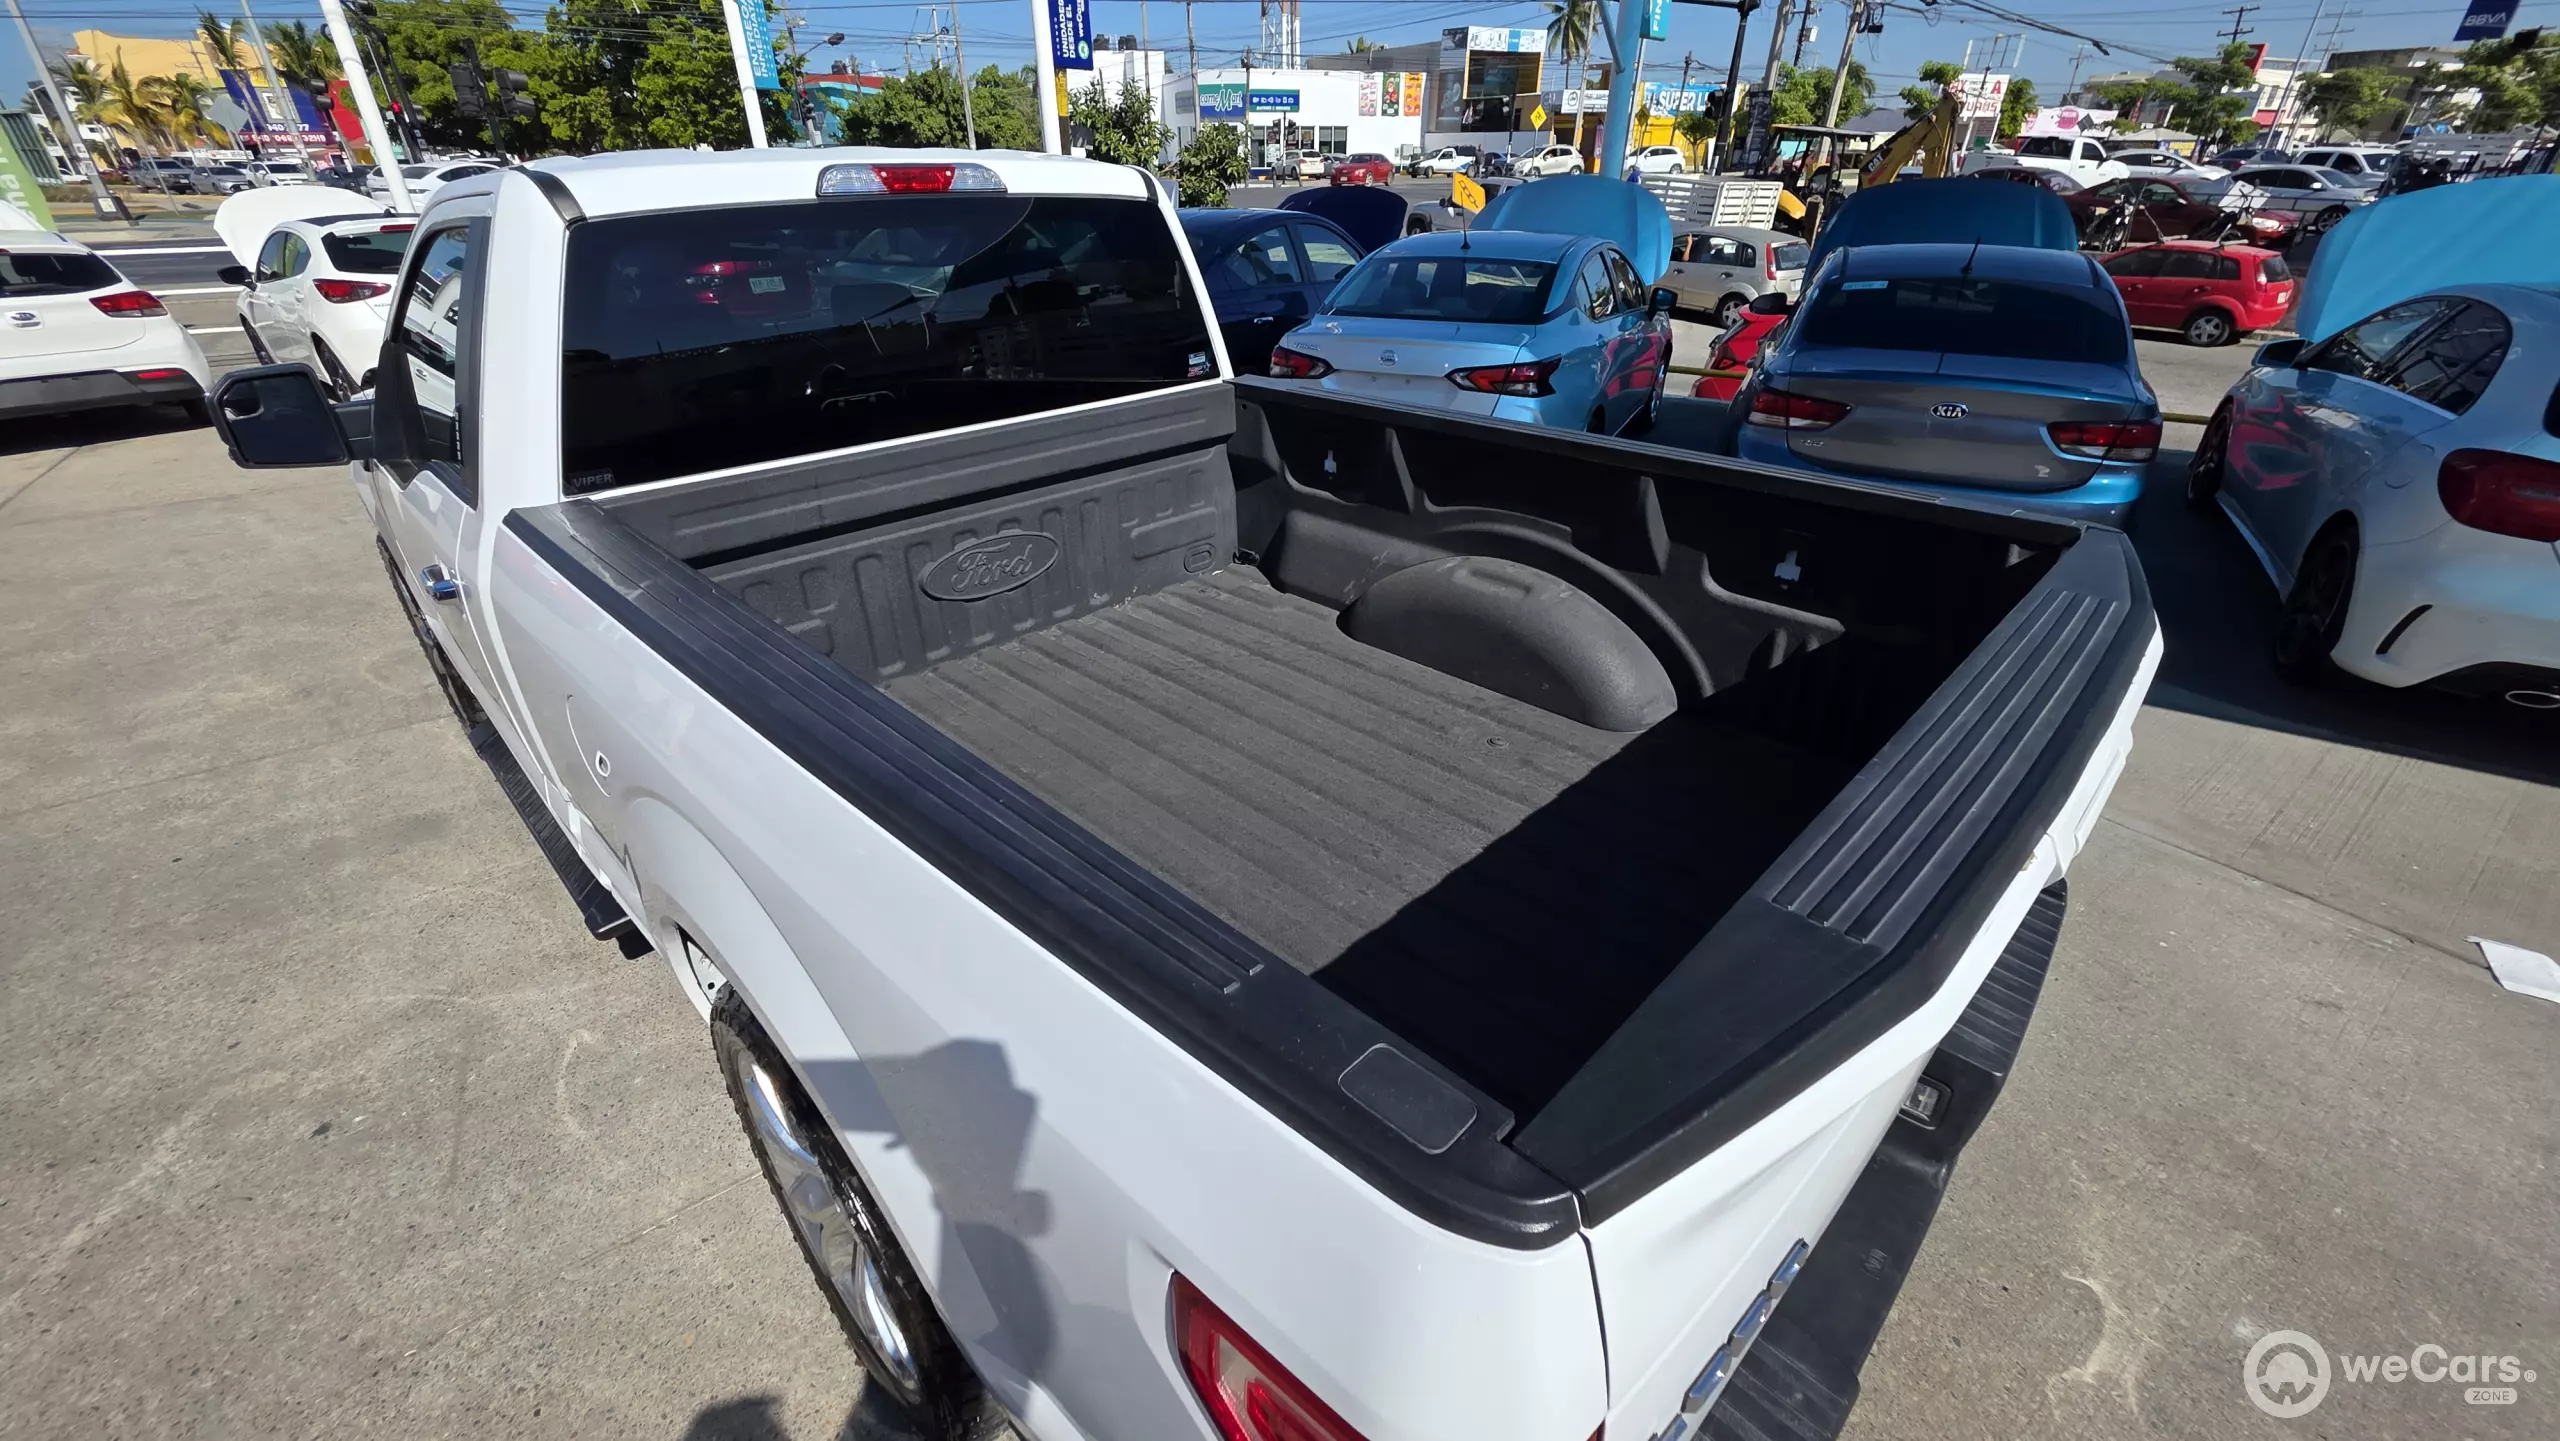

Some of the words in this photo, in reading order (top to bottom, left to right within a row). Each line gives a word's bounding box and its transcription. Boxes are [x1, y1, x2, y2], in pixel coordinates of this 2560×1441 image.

[1065, 3, 1072, 18] EL
[2464, 12, 2507, 26] BBVA
[1066, 20, 1076, 58] DESDE
[1659, 89, 1696, 111] SUPER
[1868, 152, 1883, 172] CAT
[1937, 405, 1962, 417] KIA
[573, 473, 613, 488] VIPER
[951, 542, 1032, 592] Ford
